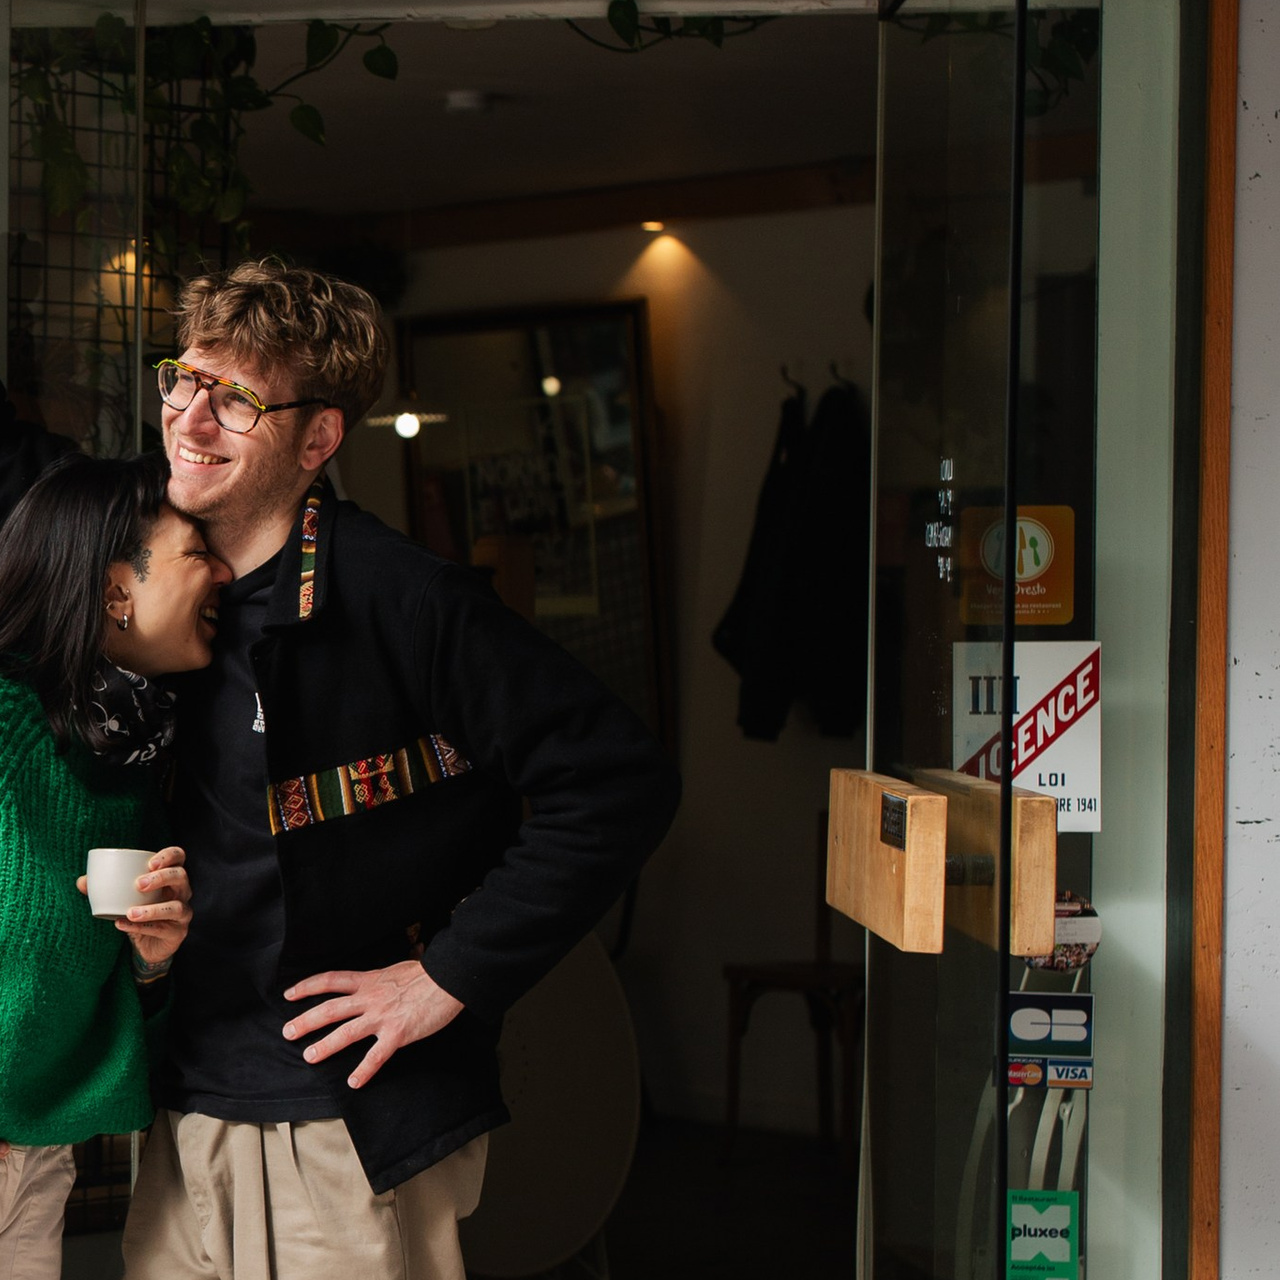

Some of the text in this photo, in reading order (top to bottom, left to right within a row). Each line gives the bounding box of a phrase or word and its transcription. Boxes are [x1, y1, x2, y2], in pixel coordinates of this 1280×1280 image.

[964, 661, 1095, 780] ICENCE
[1038, 773, 1066, 787] LOI
[1077, 798, 1097, 812] 1941
[1055, 1067, 1088, 1080] VISA
[1010, 1224, 1071, 1242] pluxee
